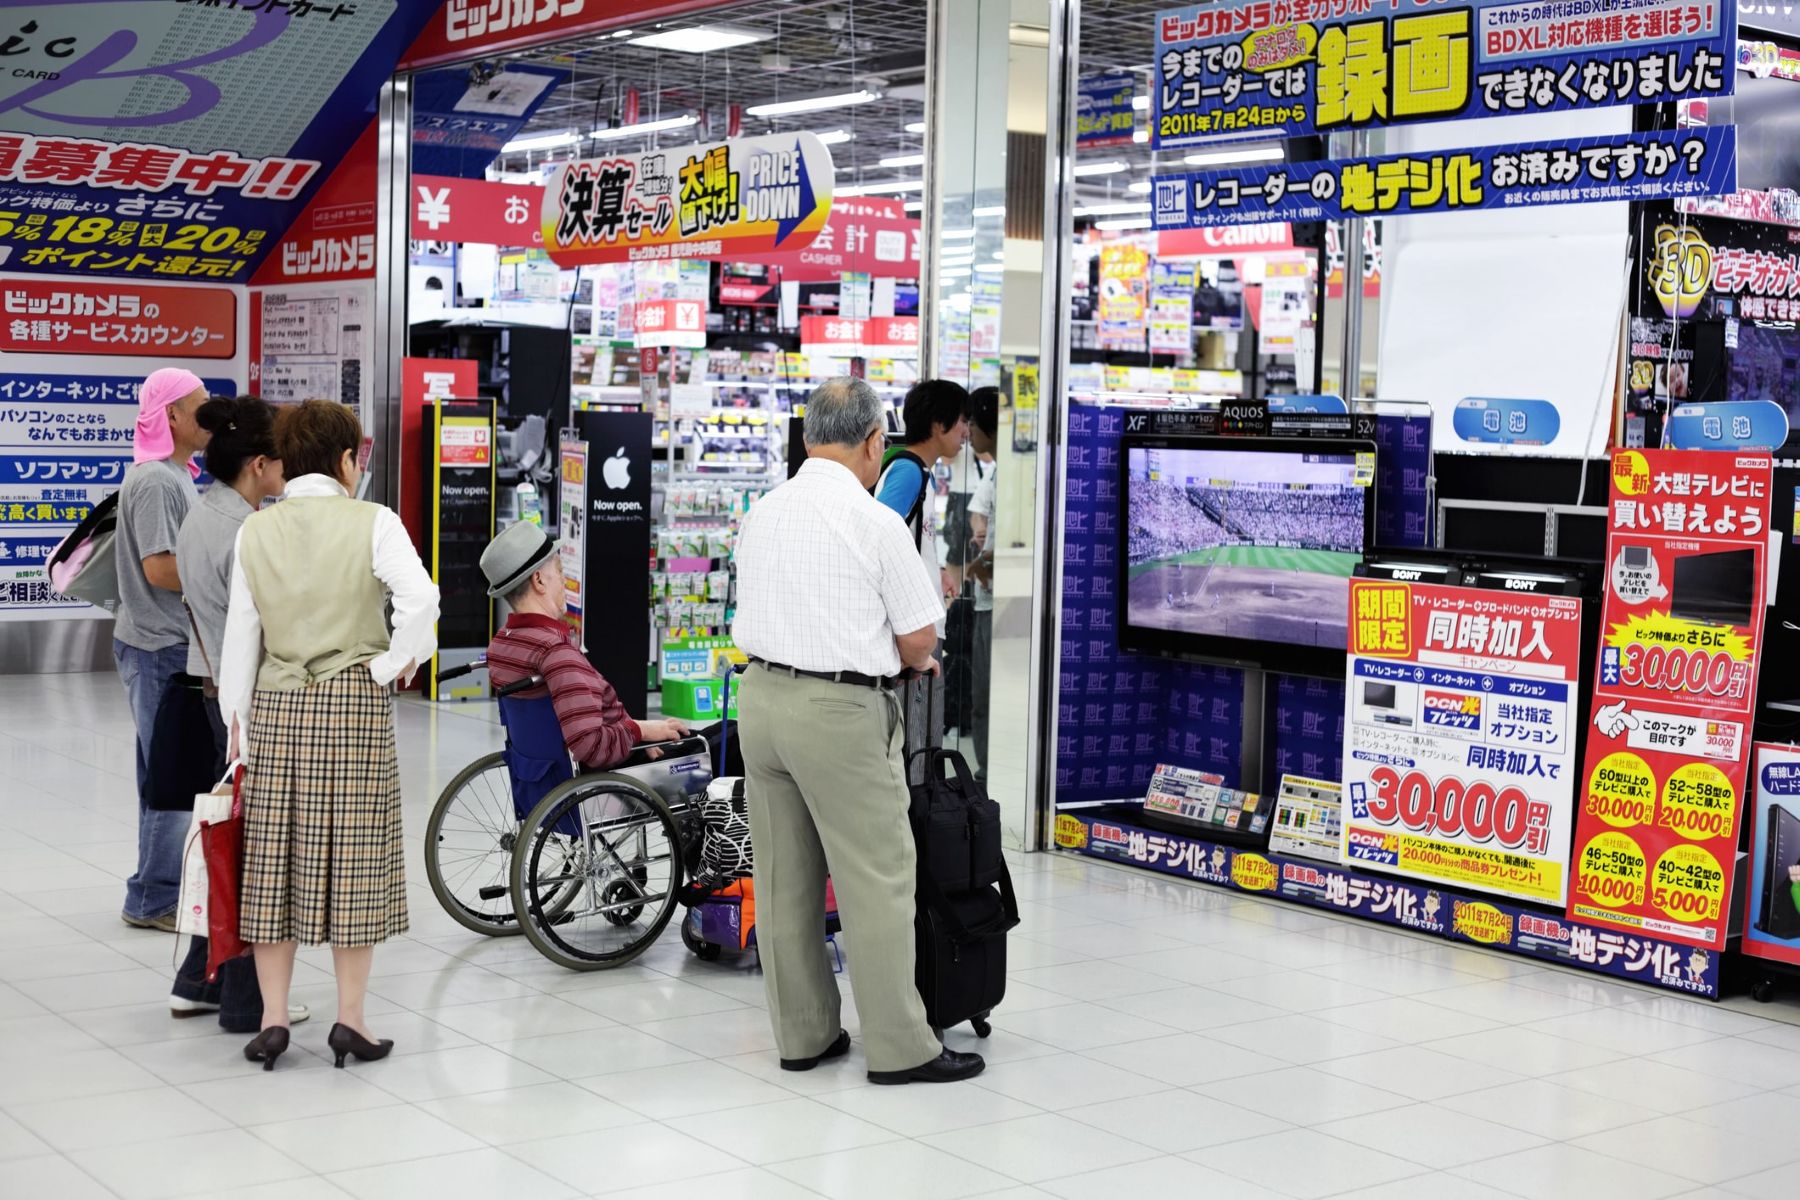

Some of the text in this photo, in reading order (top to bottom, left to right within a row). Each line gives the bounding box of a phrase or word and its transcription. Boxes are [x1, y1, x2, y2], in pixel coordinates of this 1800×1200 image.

[1255, 26, 1298, 51] アナログ
[1487, 11, 1714, 54] BDXL対応機種を選ぼう!
[1162, 45, 1243, 79] 今までの
[1247, 40, 1307, 69] のみはダメ!
[12, 68, 60, 81] CARD
[1316, 18, 1471, 126] 録画
[1478, 50, 1723, 110] できなくなりました
[1162, 69, 1306, 110] レコーダーでは
[1160, 105, 1306, 136] 2011年7月24日から
[680, 147, 729, 202] 大幅
[750, 150, 800, 188] PRICE
[1195, 139, 1705, 213] レコーダーの 地デジ化 お済みですか?
[115, 193, 224, 221] さらに
[746, 186, 801, 223] DOWN
[47, 215, 136, 246] 18%
[162, 224, 258, 255] 20%
[1203, 224, 1287, 247] Canon
[20, 246, 246, 277] ポイント還元!
[282, 234, 375, 276] ビックカメラ
[800, 252, 843, 266] CASHIER
[1660, 242, 1711, 295] 3D
[5, 290, 160, 319] ビックカメラの
[10, 318, 225, 346] 各種サービスカウンター
[0, 409, 107, 424] パソコンのことなら
[1127, 415, 1148, 432] XF
[1223, 406, 1264, 421] AQUOS
[1483, 409, 1527, 432] 電池
[1703, 416, 1751, 438] 電池
[1614, 455, 1648, 495] 最新
[1653, 471, 1765, 498] 大型テレビに
[41, 488, 88, 501] 査定無料
[442, 486, 489, 497] Now open.
[594, 500, 643, 512] Now open.
[1613, 499, 1764, 537] 買い替えよう
[1392, 569, 1422, 581] SONY
[1505, 579, 1537, 591] SONY
[1357, 588, 1406, 620] 期間
[1539, 608, 1579, 621] オプション
[1358, 620, 1407, 650] 限定
[1425, 610, 1553, 661] 同時加入
[1635, 629, 1726, 648] ビック特価より さらに
[1602, 648, 1618, 684] 最大
[1431, 673, 1476, 687] インターネット
[1508, 682, 1547, 696] オプション
[1425, 694, 1482, 717] OCN光
[1429, 710, 1477, 728] フレッツ
[1497, 703, 1553, 725] 当社指定
[1490, 722, 1558, 744] オプション
[1642, 719, 1697, 736] このマークが
[1648, 732, 1687, 748] 目印です
[1466, 745, 1561, 780] 同時加入で
[1594, 781, 1651, 799] テレビご購入で
[1598, 768, 1649, 787] 60型以上の
[1351, 784, 1367, 818] 最大
[1668, 792, 1730, 811] テレビご購入で
[1092, 822, 1129, 844] 録画機の
[1127, 831, 1207, 873] 地デジ化
[1349, 832, 1398, 851] OCN光
[1353, 846, 1393, 863] フレッツ
[1585, 859, 1643, 879] テレビご購入で
[1658, 872, 1720, 893] テレビご購入で
[1283, 863, 1326, 887] 録画機の
[1325, 872, 1418, 919] 地デジ化
[1453, 900, 1513, 931] 2011年7月24日
[1519, 914, 1569, 940] 録画機の
[1569, 926, 1682, 979] 地デジ化
[1661, 974, 1714, 994] お済みですか?
